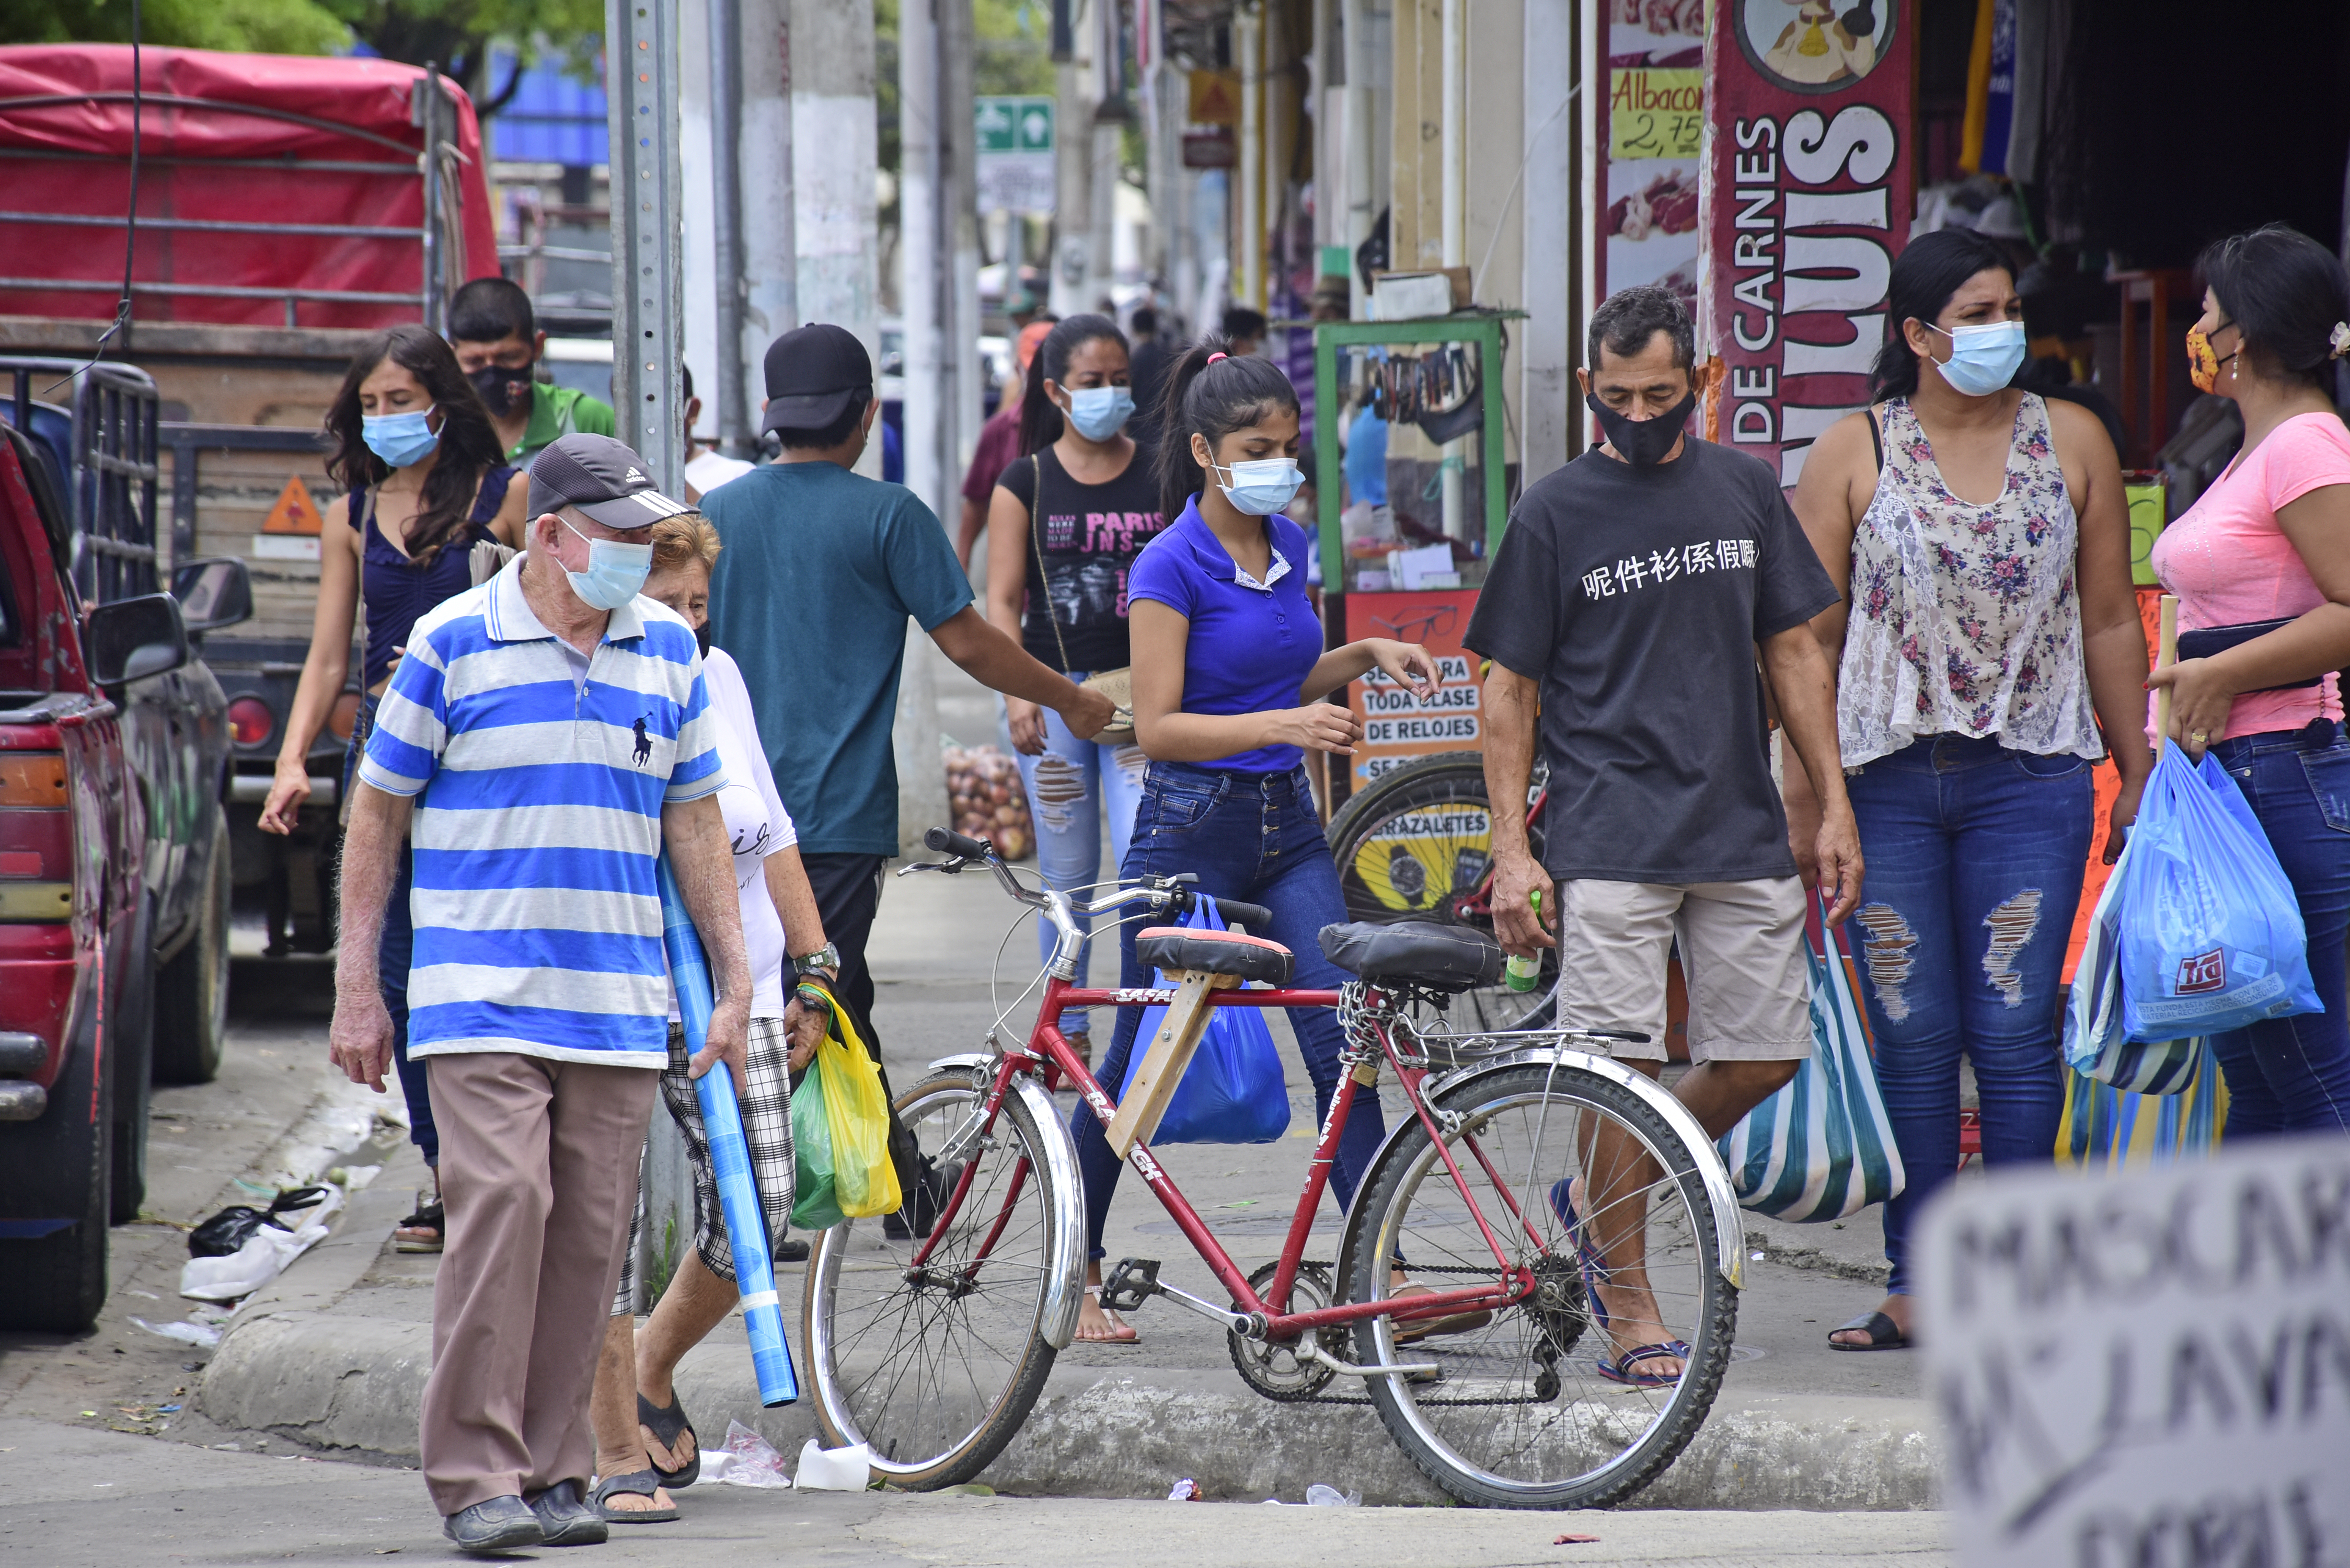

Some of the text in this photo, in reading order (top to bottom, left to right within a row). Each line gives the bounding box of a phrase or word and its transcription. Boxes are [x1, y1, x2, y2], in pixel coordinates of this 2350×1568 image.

[1622, 113, 1701, 157] 2,75
[1782, 106, 1895, 377] LUIS
[1733, 118, 1777, 444] DE CARNES
[1086, 512, 1166, 532] PARIS
[1582, 539, 1759, 601] 呢件衫係假嘅
[1366, 694, 1412, 710] TODA
[1369, 719, 1474, 740] DE RELOJES
[2156, 1004, 2182, 1012] FUNDA
[2205, 997, 2232, 1006] HECHA
[2233, 990, 2250, 1000] CON
[2252, 983, 2266, 993] 70%
[2267, 977, 2276, 985] DE
[2178, 1005, 2220, 1016] RECICLADO
[2222, 985, 2278, 1008] POSTCONSUMO
[1318, 1064, 1352, 1146] RALEIGH
